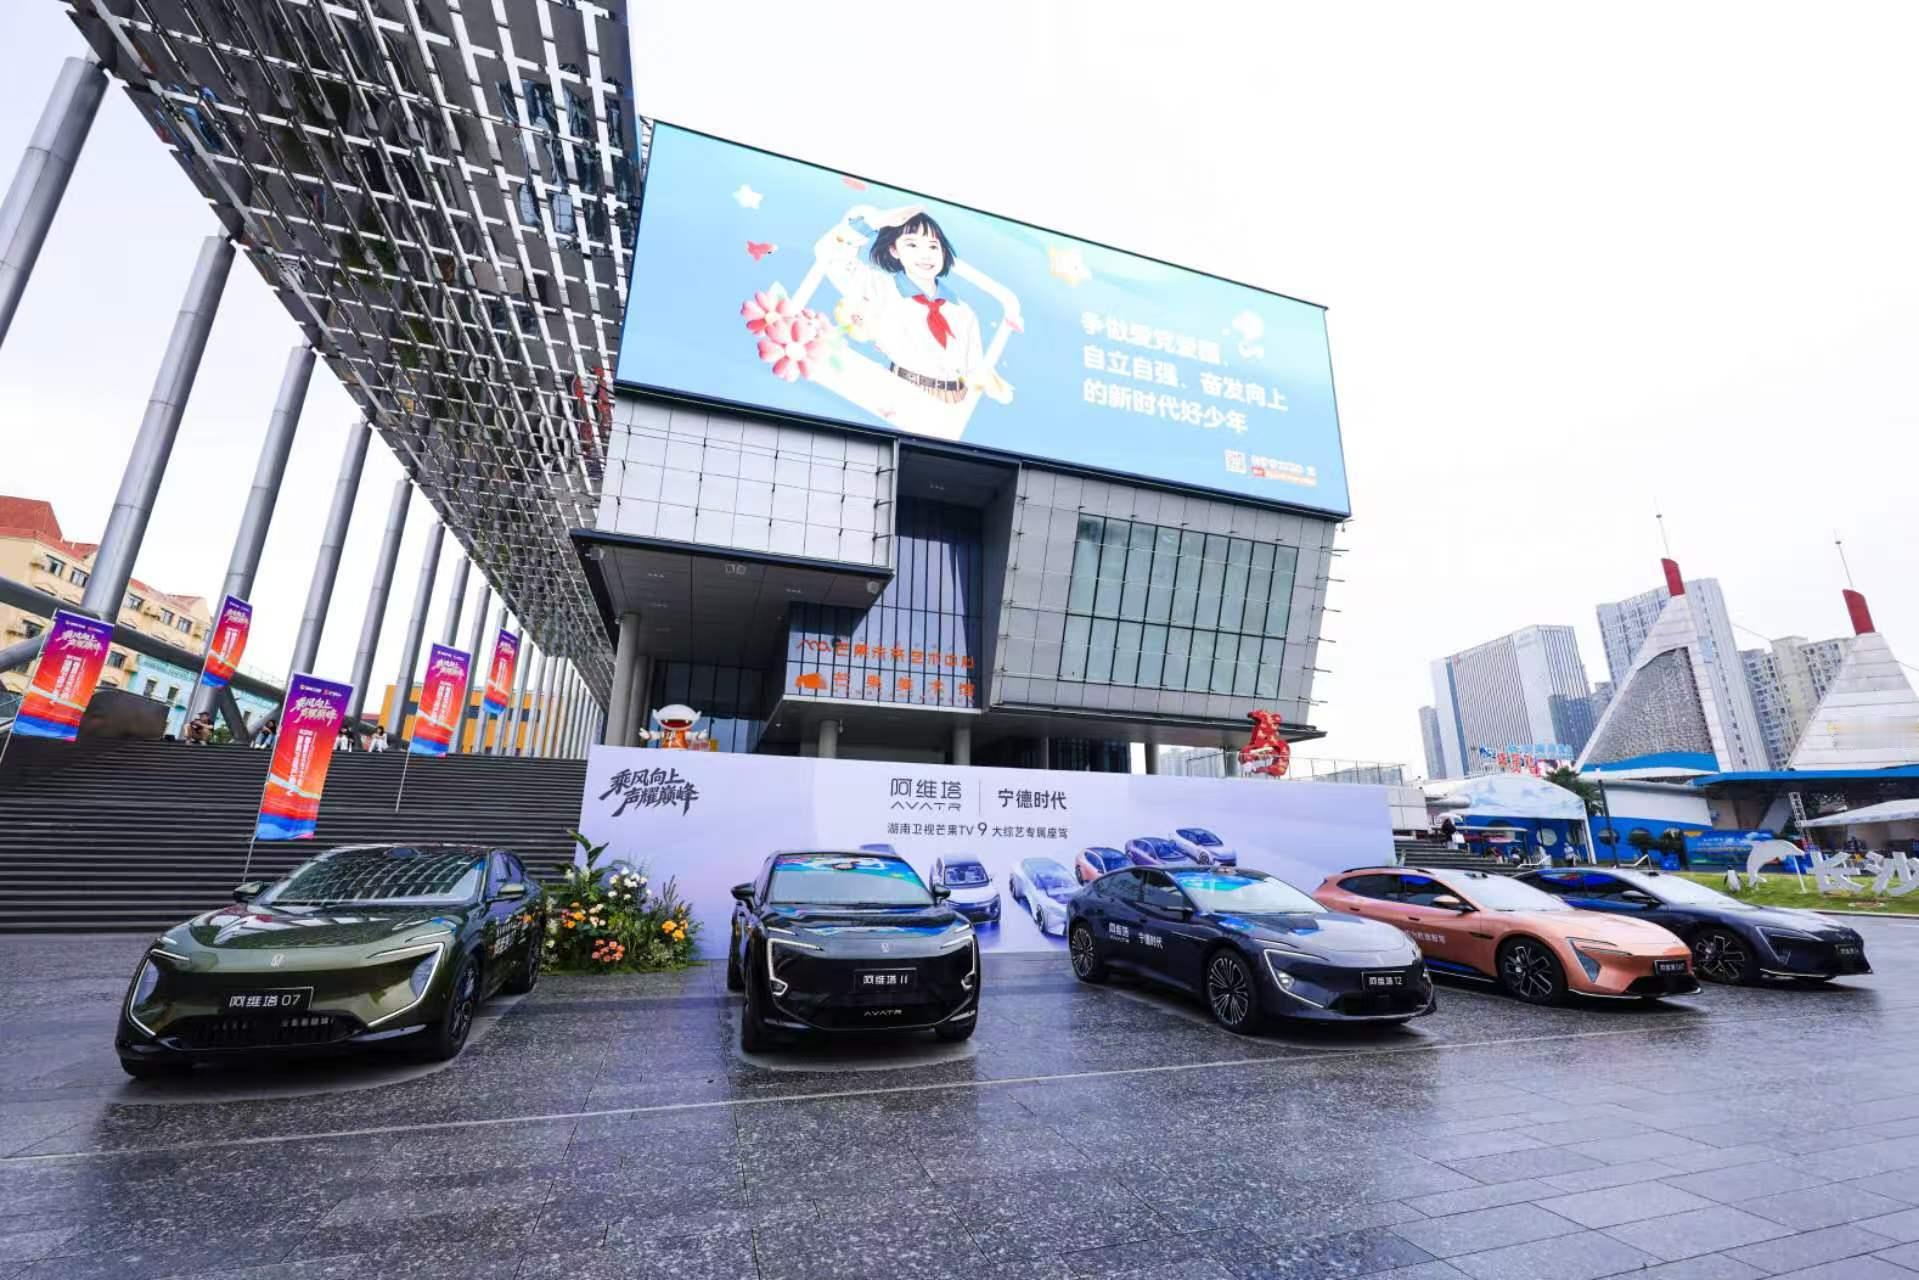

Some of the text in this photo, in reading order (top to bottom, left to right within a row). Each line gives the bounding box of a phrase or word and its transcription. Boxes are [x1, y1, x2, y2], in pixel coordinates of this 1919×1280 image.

[1083, 378, 1248, 434] 的新时代好少年
[598, 767, 685, 801] 乘风向上
[611, 782, 700, 817] 声耀巅峰
[890, 778, 962, 799] 阿维塔
[998, 788, 1067, 810] 宁德时代
